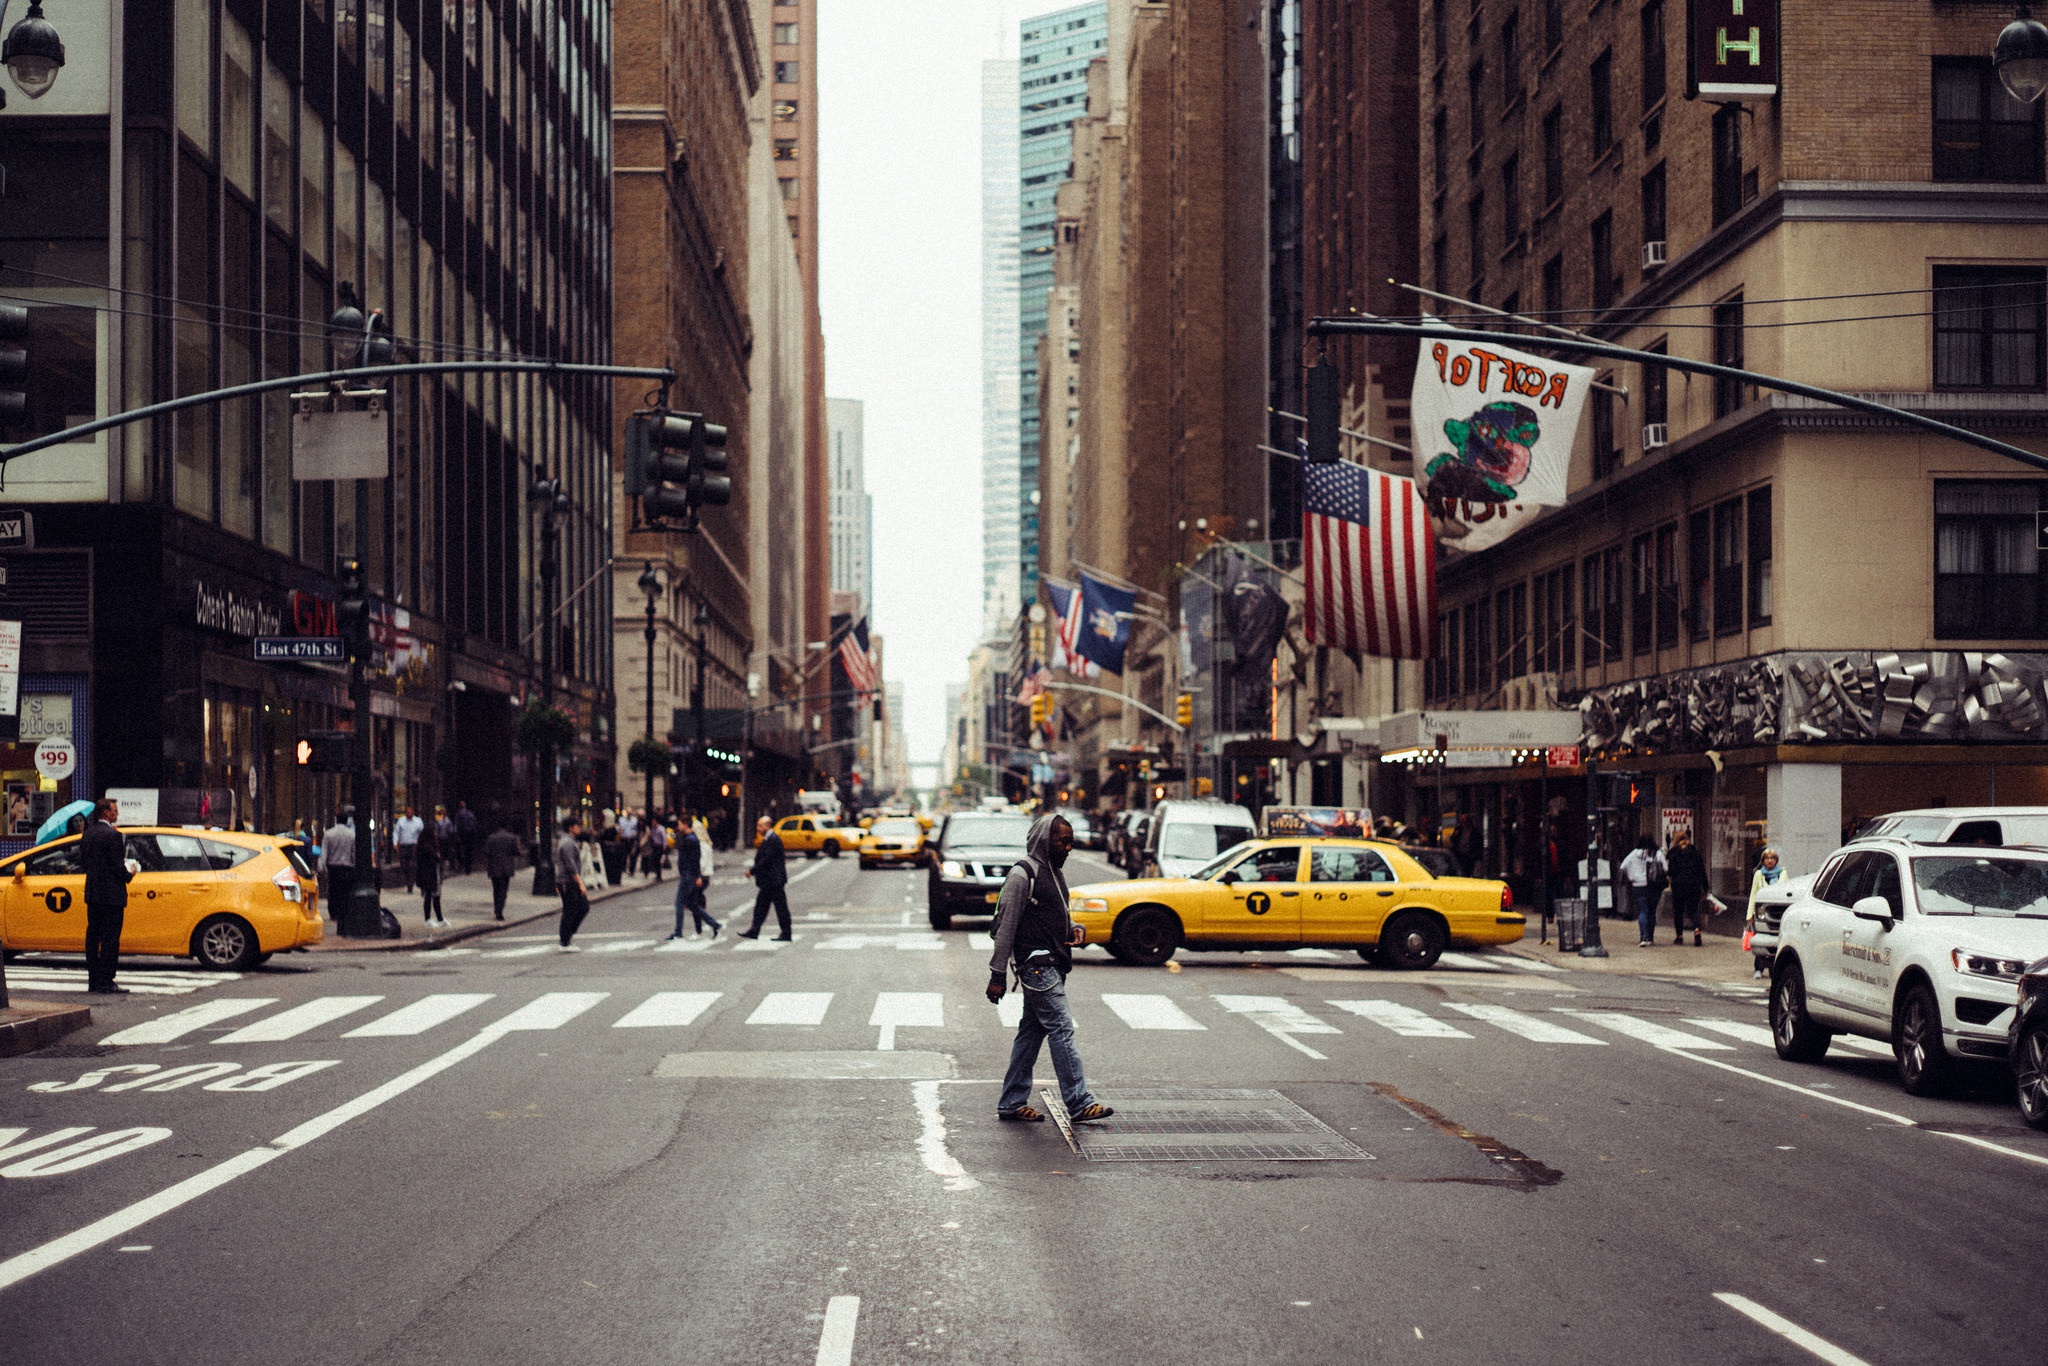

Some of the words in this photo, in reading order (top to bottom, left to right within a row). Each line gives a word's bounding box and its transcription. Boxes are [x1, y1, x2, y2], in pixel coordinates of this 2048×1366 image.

[197, 581, 226, 630] Cohen's
[261, 642, 288, 655] East
[292, 642, 320, 655] 47th
[324, 642, 337, 655] St
[41, 751, 68, 765] $99
[27, 1060, 343, 1093] BUS
